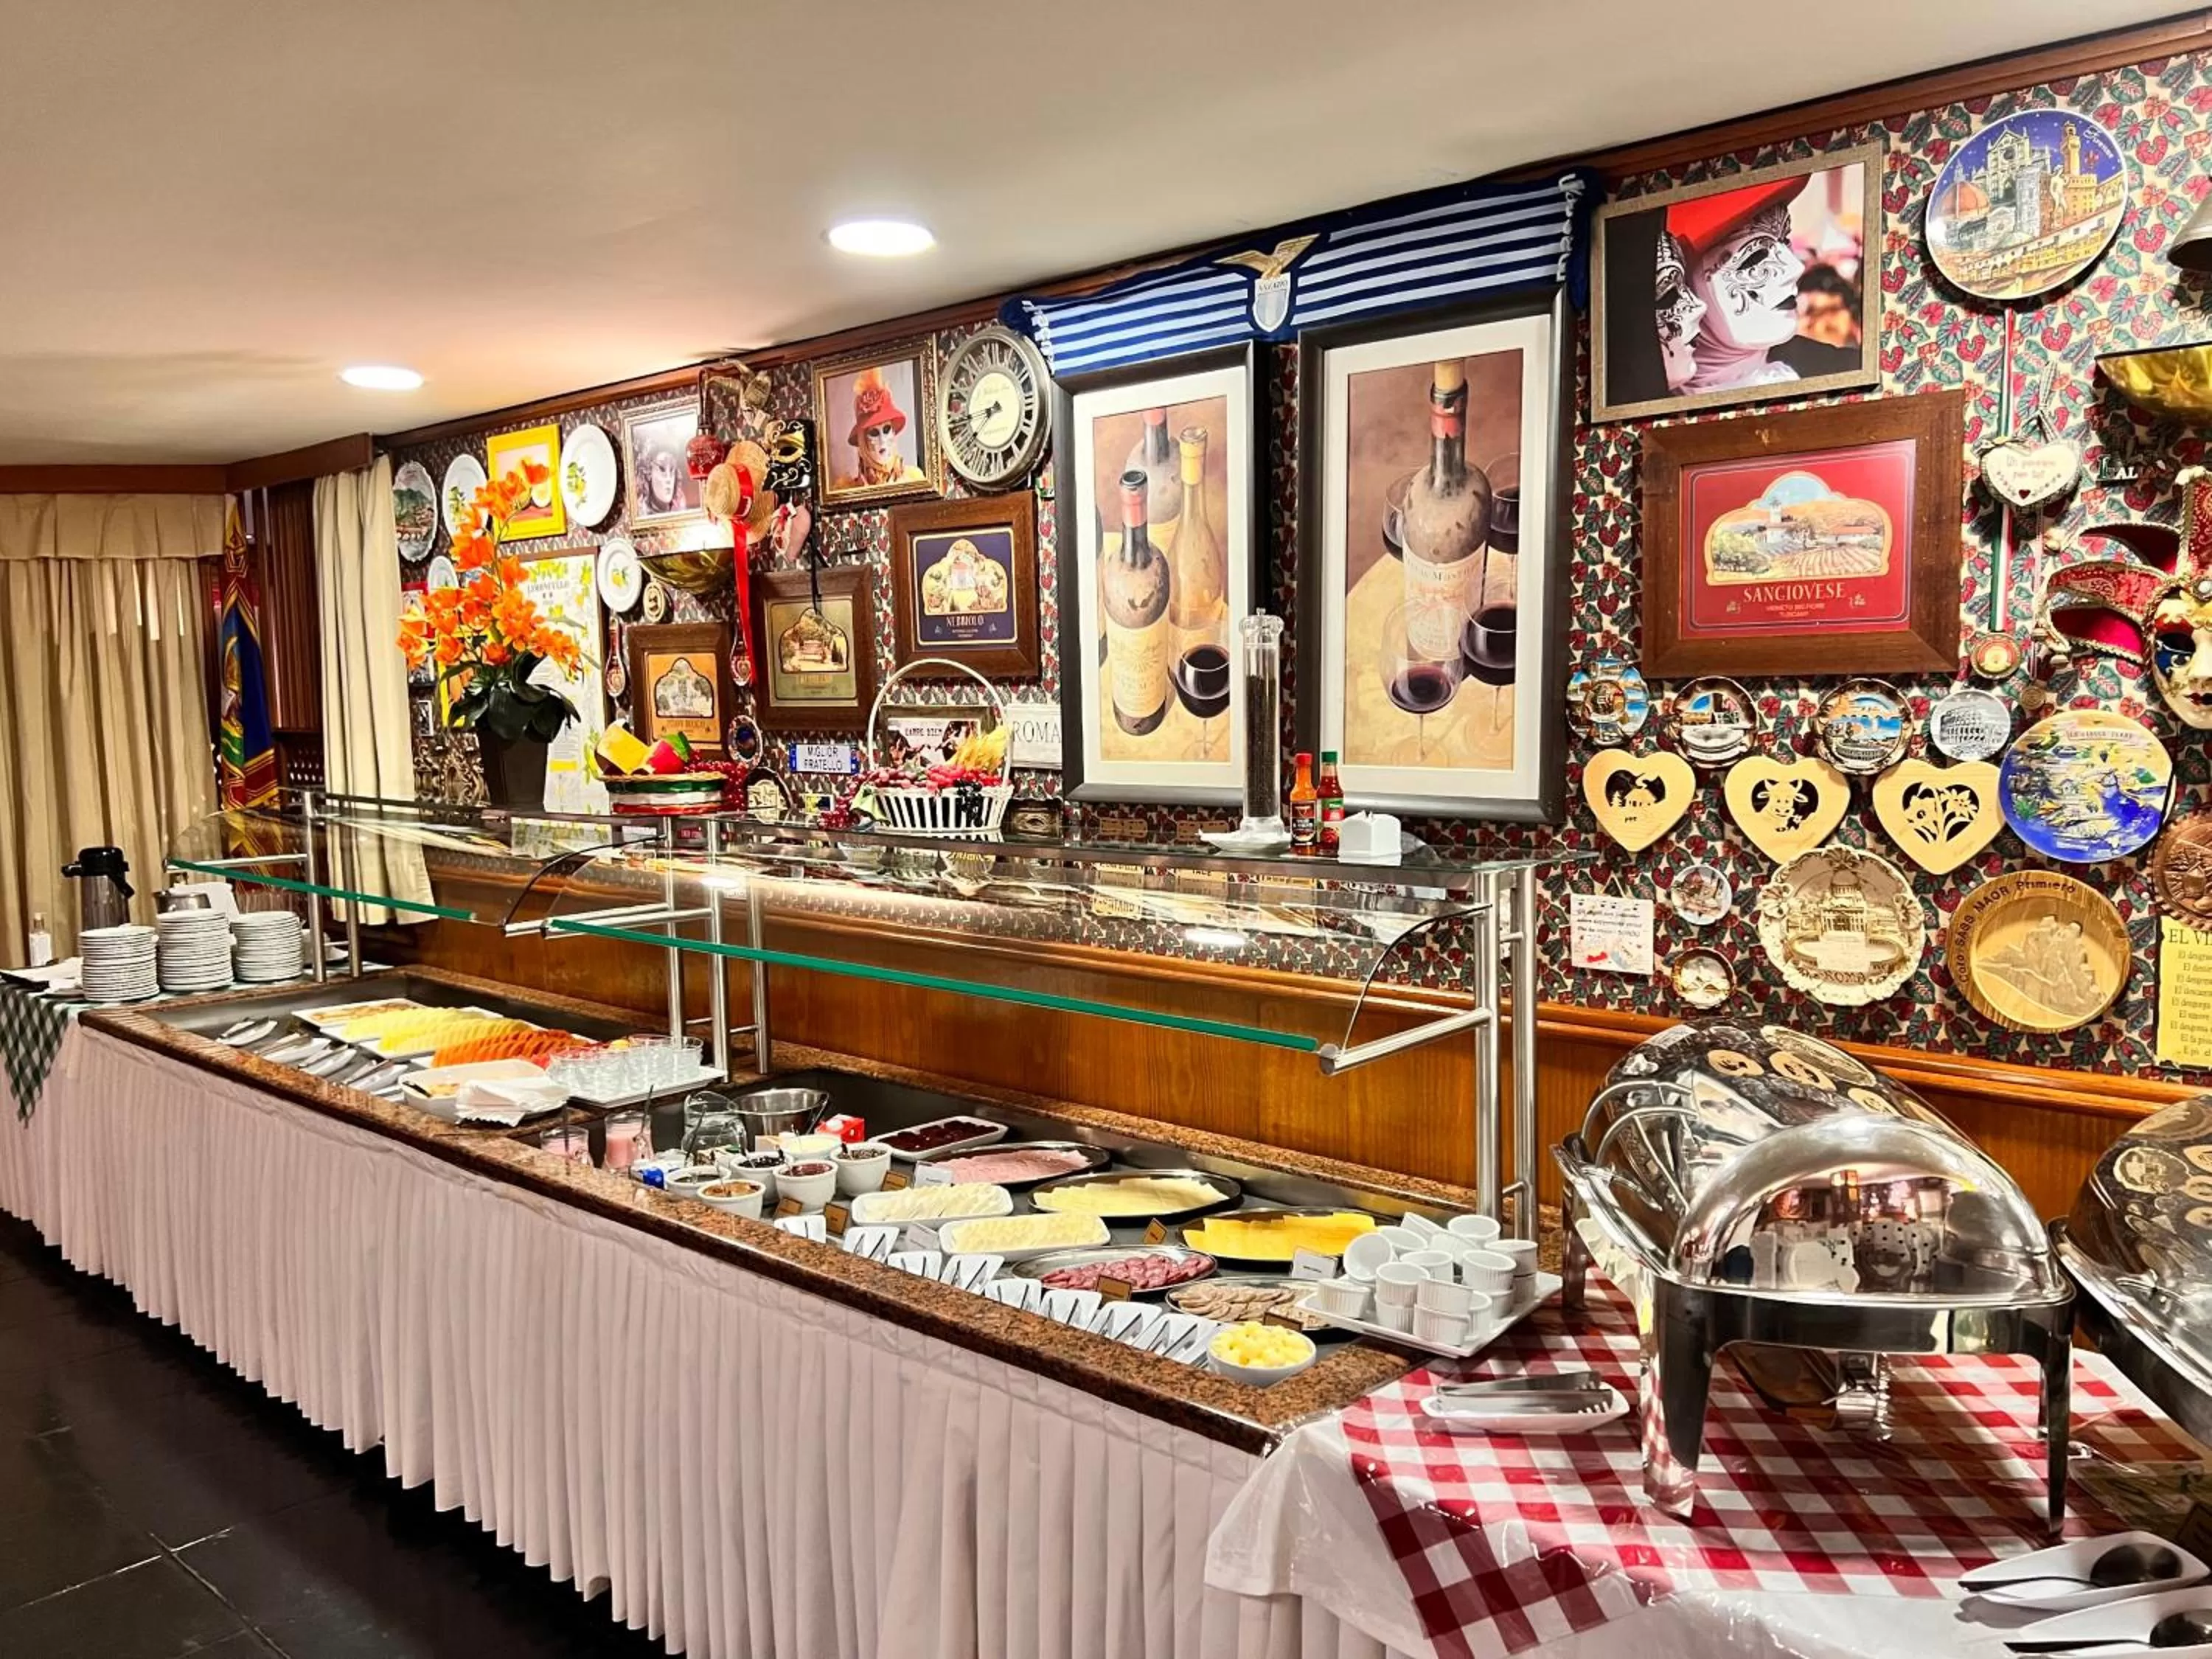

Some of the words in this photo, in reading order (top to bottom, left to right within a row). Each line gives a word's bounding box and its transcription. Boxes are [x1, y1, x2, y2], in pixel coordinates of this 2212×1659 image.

[1012, 720, 1061, 743] ROMA
[804, 758, 843, 771] FRATELLO
[1973, 885, 2010, 913] MAOR
[2015, 880, 2076, 894] Primiero
[2169, 928, 2189, 945] EL
[2194, 930, 2212, 946] VI
